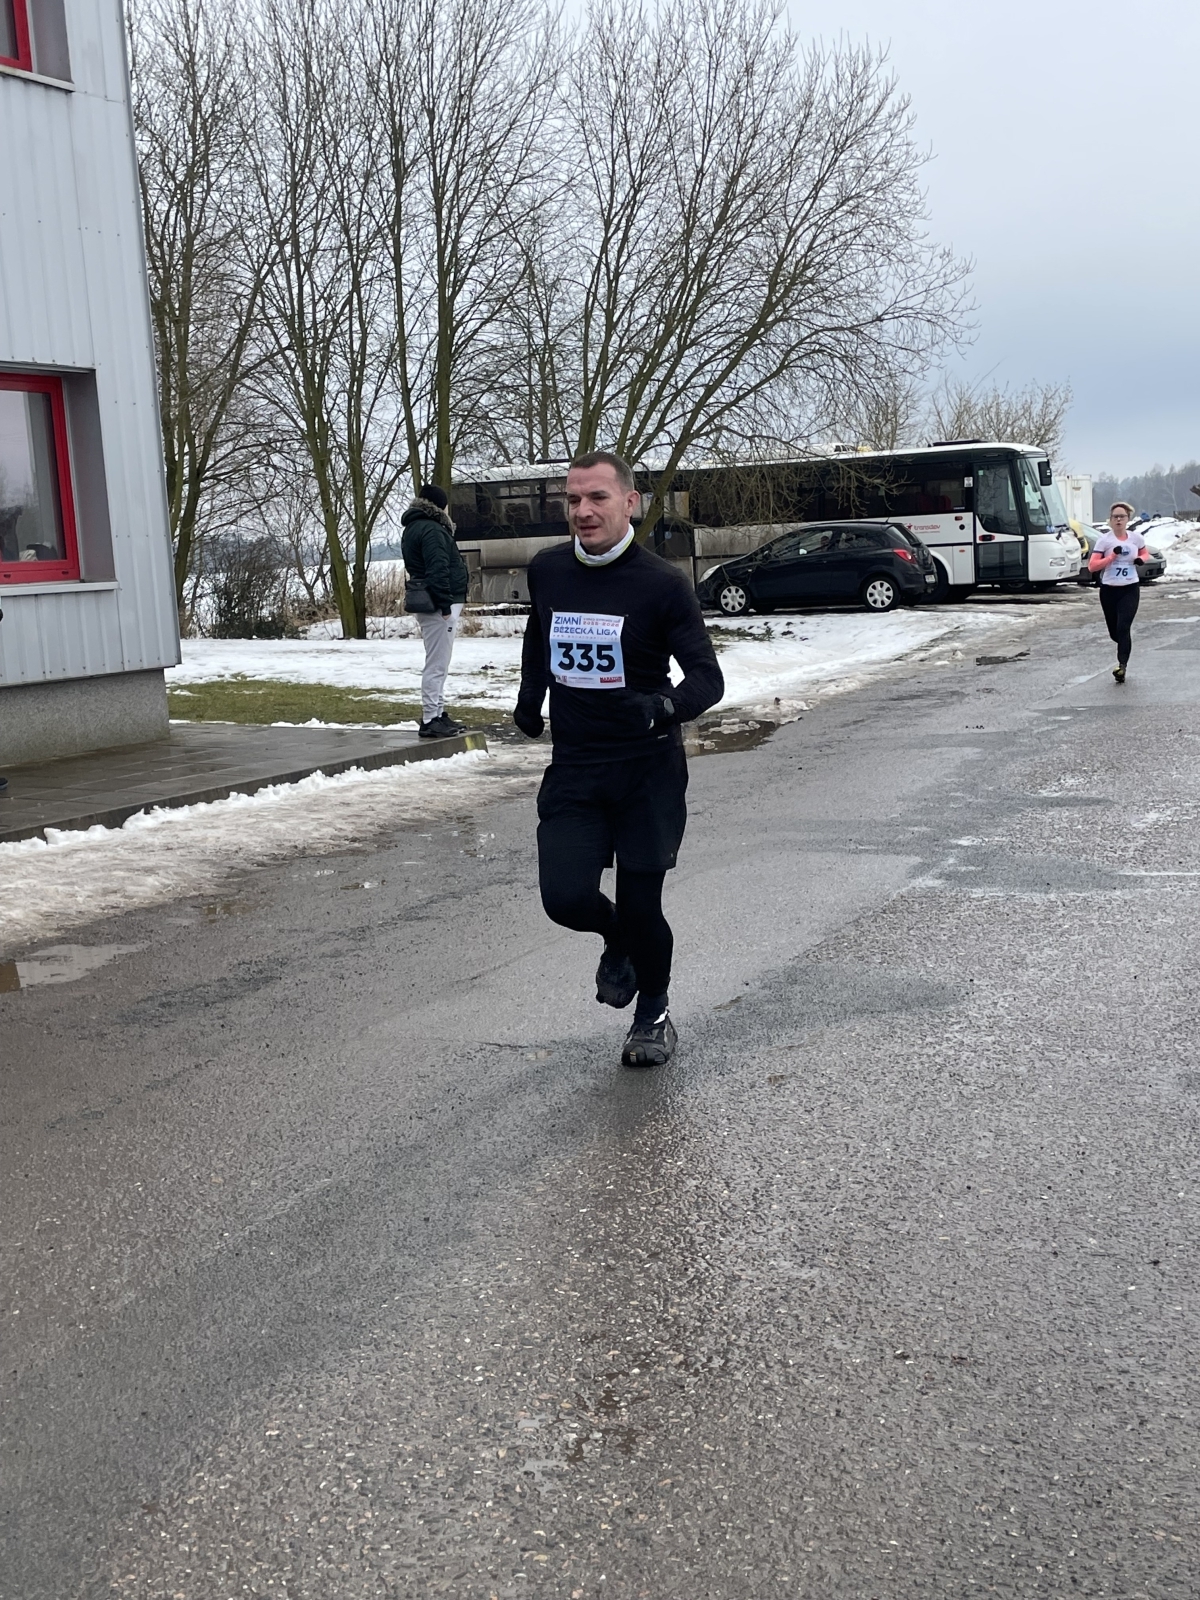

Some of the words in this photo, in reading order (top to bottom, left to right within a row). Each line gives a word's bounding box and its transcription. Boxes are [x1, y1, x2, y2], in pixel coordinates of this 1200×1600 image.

[1115, 567, 1128, 577] 76
[554, 616, 582, 625] ZIMNÍ
[553, 626, 594, 635] BĚŽECKÁ
[557, 642, 616, 672] 335
